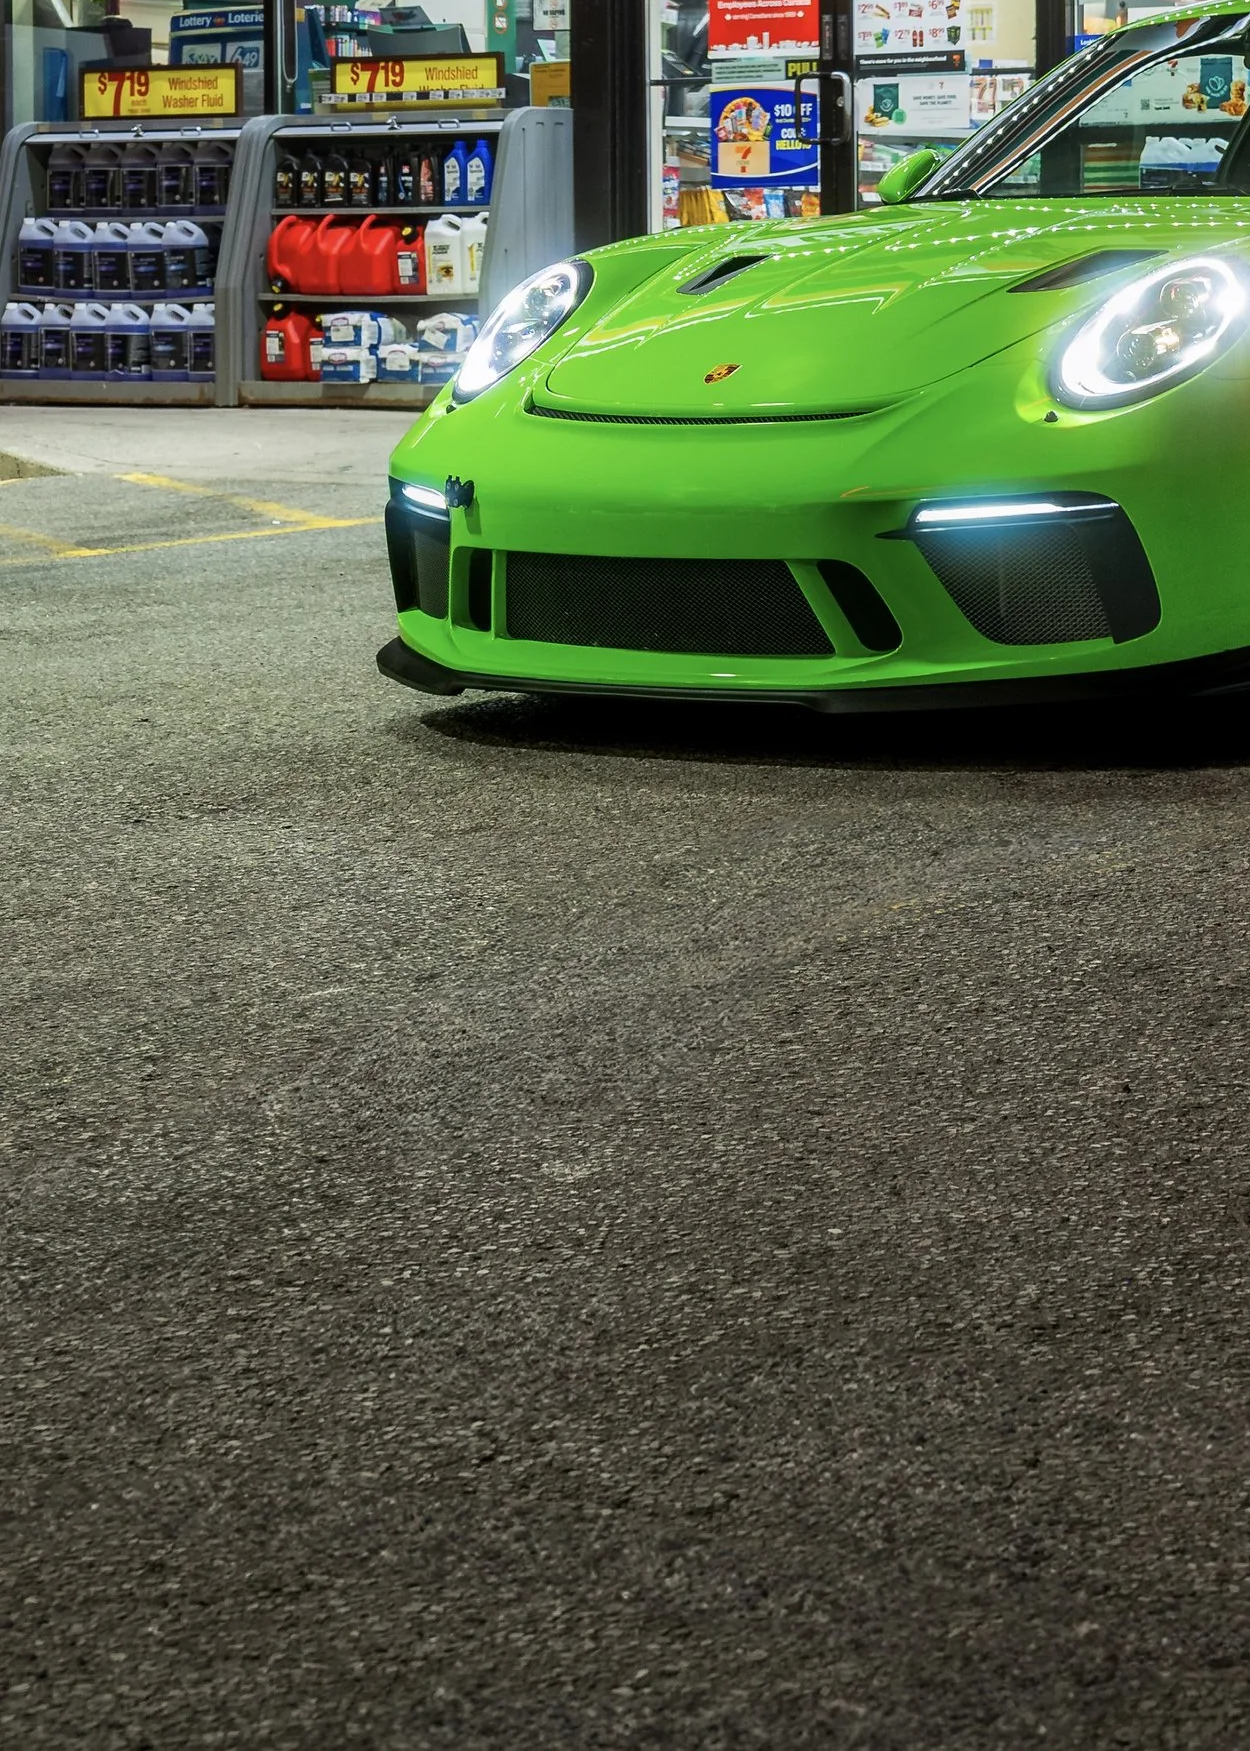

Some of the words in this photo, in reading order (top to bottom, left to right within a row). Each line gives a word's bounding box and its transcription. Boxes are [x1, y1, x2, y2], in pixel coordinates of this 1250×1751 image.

[179, 15, 212, 28] Lottery
[424, 66, 478, 81] Windshied
[162, 95, 199, 109] Washer
[202, 93, 224, 108] Fluid
[774, 103, 792, 117] $10
